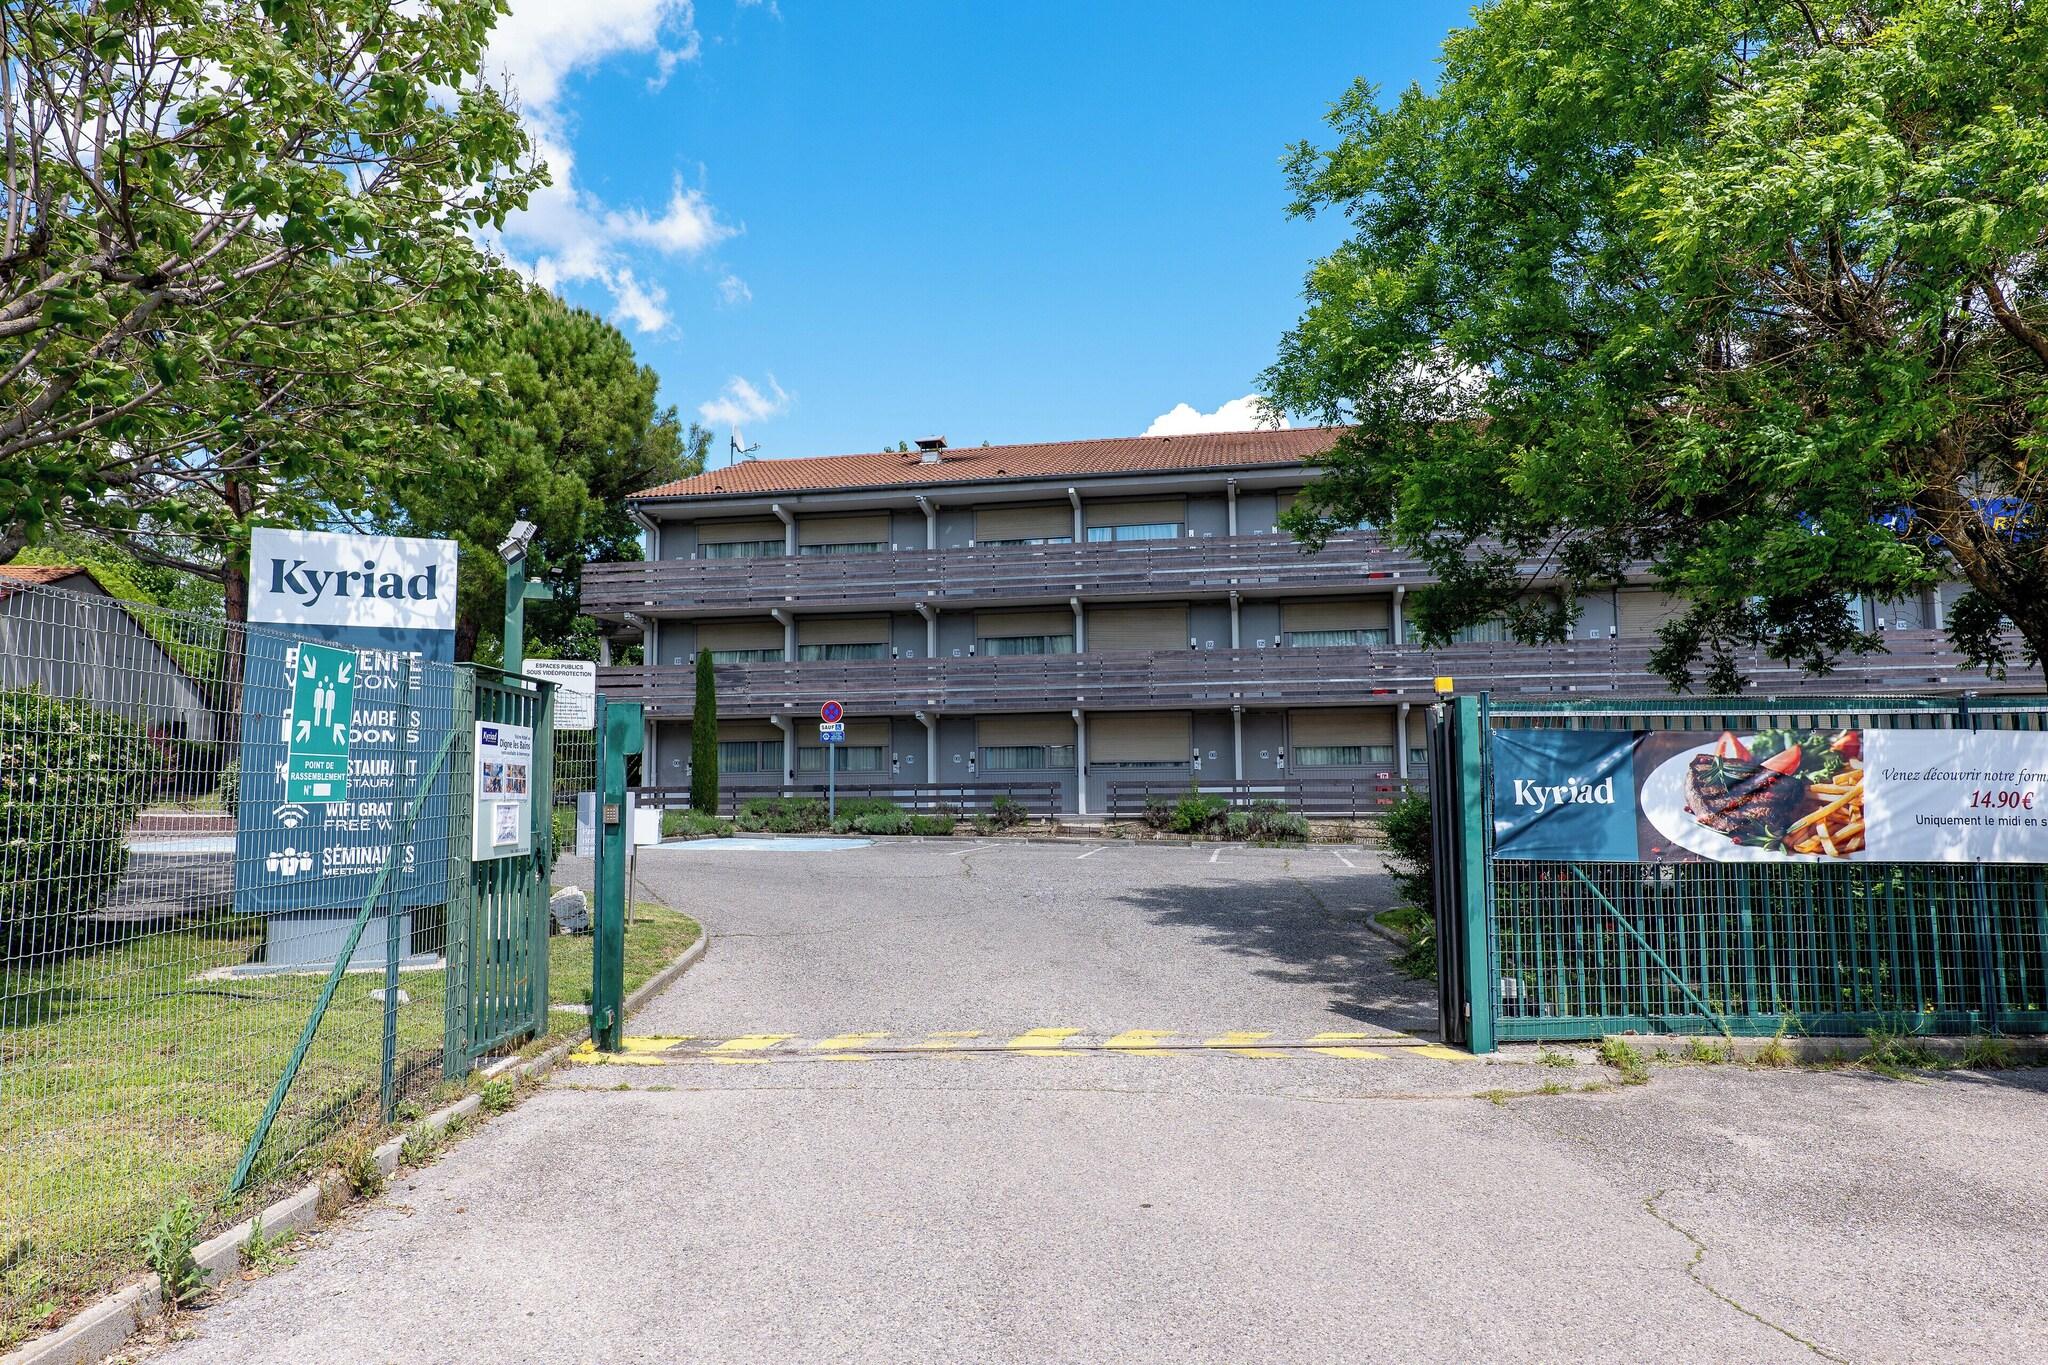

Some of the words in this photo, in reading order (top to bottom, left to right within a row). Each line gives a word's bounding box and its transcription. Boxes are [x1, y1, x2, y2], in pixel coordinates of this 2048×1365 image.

[269, 558, 438, 607] Kyriad
[304, 760, 324, 769] POINT
[325, 761, 335, 770] DE
[290, 772, 346, 781] RASSEMBLEMENT
[1881, 768, 1921, 781] Venez
[1923, 767, 1982, 781] découvrir
[1984, 771, 2015, 782] notre
[2015, 768, 2048, 786] form
[1513, 776, 1615, 814] Kyriad
[326, 802, 356, 817] WIFI
[323, 819, 372, 831] FREE
[1915, 814, 1982, 827] Uniquement
[1985, 815, 1995, 825] le
[1998, 815, 2021, 826] midi
[2024, 818, 2037, 826] en
[322, 867, 373, 877] MEETING
